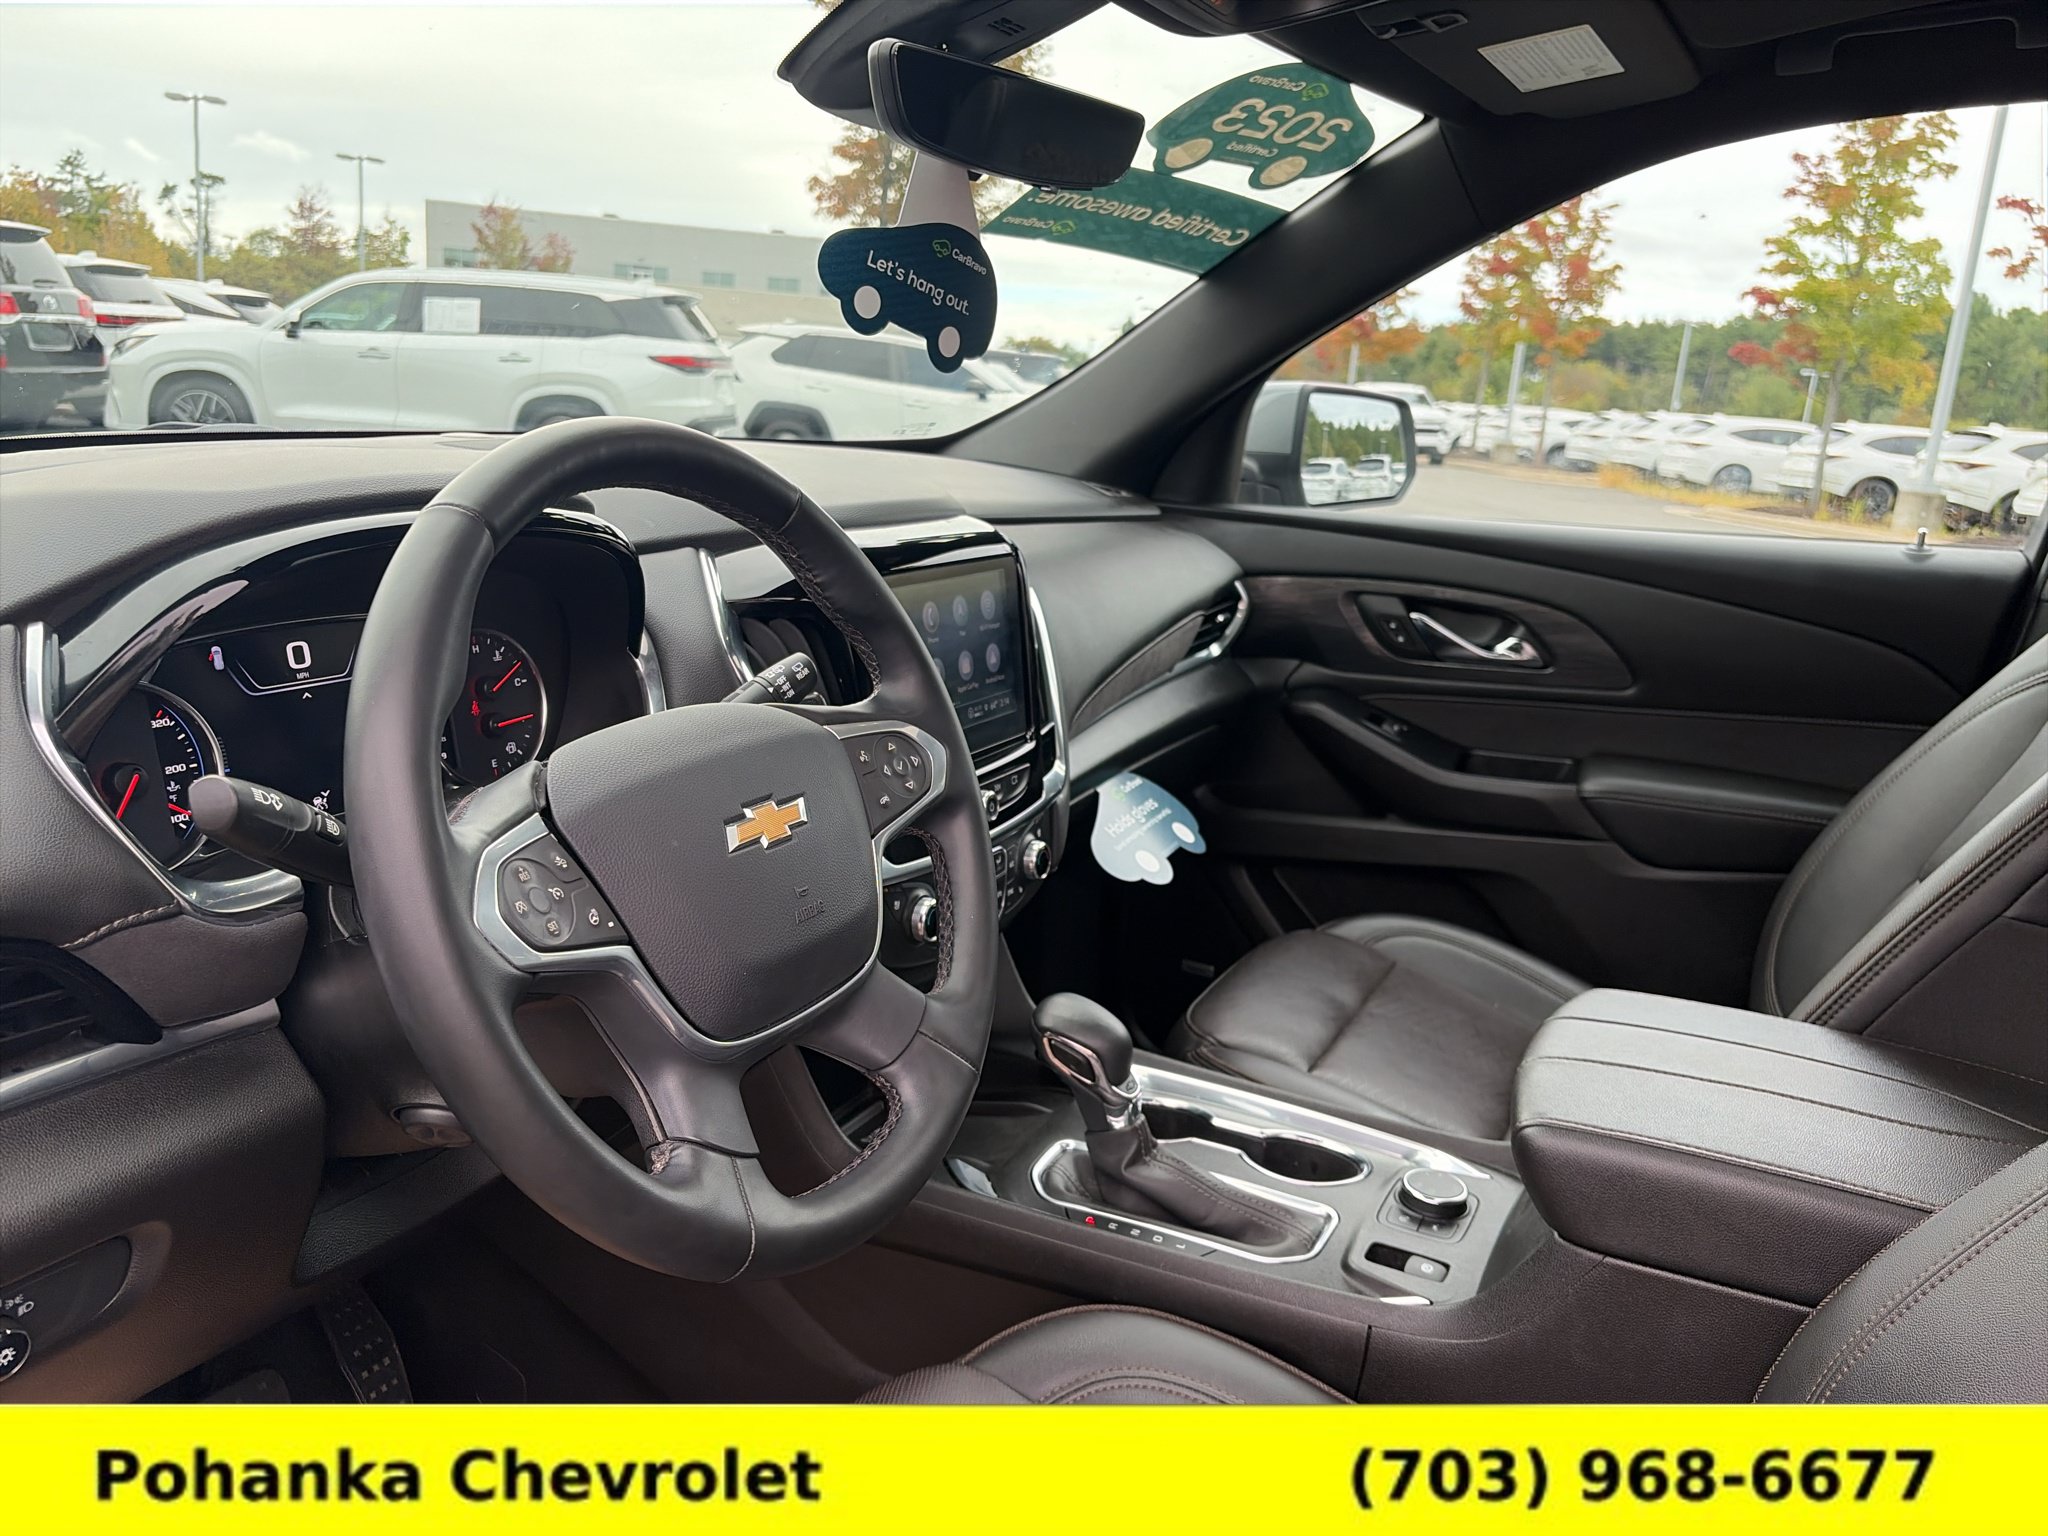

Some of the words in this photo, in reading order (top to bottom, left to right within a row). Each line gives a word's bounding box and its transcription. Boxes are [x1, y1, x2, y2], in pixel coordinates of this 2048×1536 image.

[951, 247, 987, 277] CarBravo
[866, 249, 905, 282] Let's
[906, 270, 945, 307] hang
[945, 290, 971, 317] out.
[285, 640, 312, 670] 0
[296, 672, 310, 680] MPH
[796, 668, 810, 681] REAR
[165, 763, 187, 775] 200
[171, 813, 190, 824] 100
